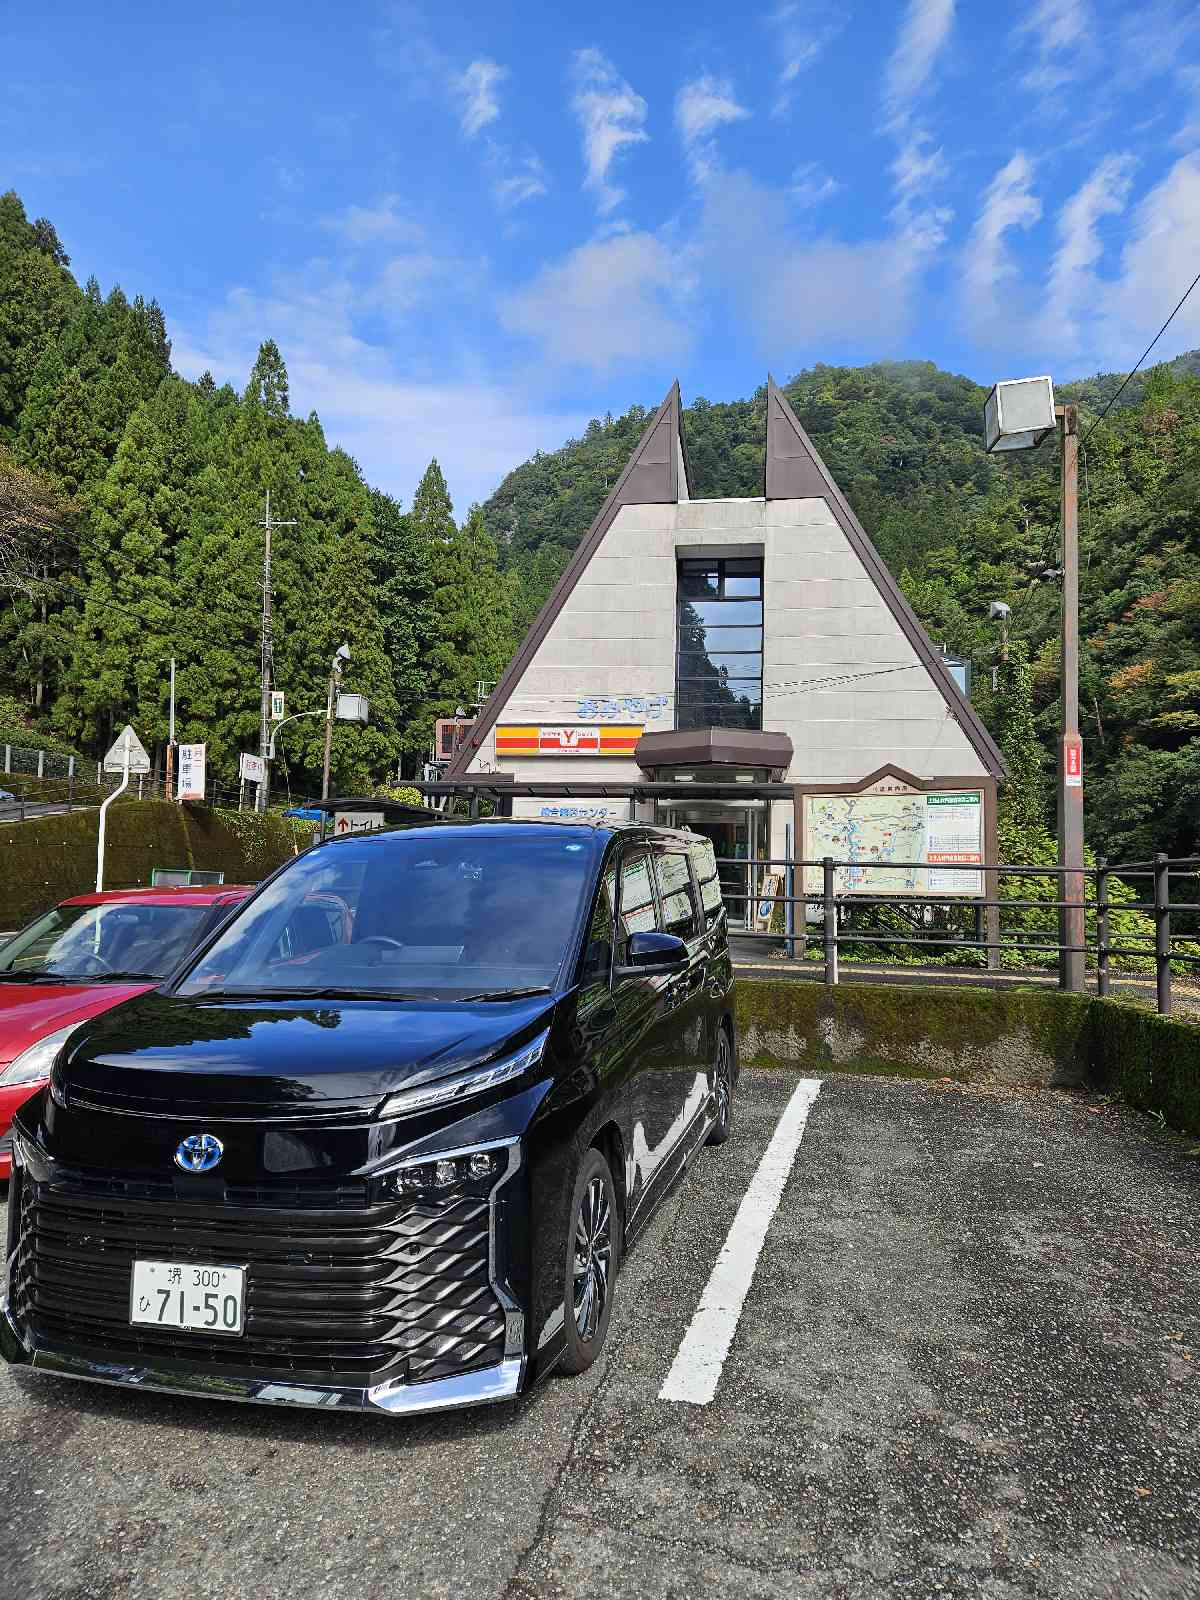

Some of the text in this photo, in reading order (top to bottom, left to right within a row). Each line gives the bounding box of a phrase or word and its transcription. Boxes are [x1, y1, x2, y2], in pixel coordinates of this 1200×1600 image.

[563, 730, 575, 744] Y
[182, 748, 192, 789] 駐車場
[167, 1267, 220, 1288] 堺 300
[139, 1288, 238, 1329] ひ 71-50
